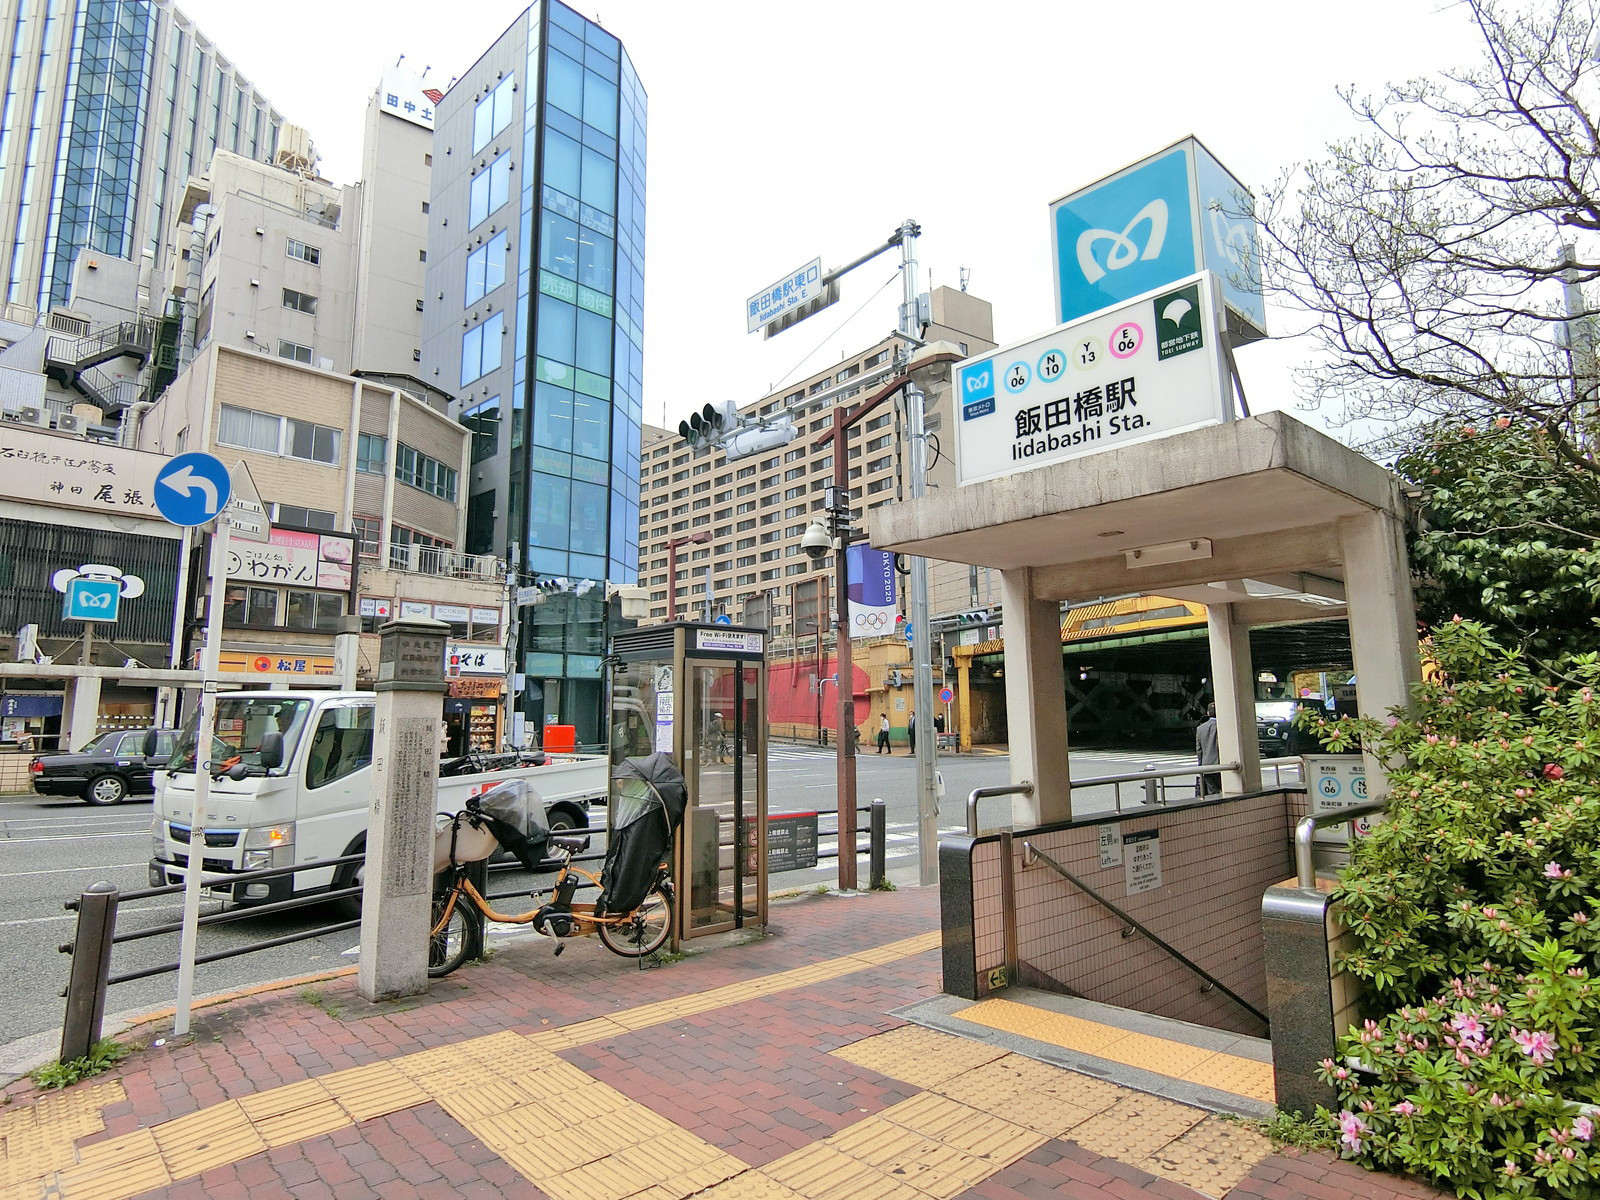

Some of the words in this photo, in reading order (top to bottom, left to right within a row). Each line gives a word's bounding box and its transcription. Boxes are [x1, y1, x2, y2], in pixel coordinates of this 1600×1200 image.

[749, 265, 818, 317] 飯田橋駅東口
[760, 301, 785, 322] Iidabashi
[1122, 329, 1128, 339] E
[1161, 331, 1199, 349] 都営地下鉄
[1083, 342, 1091, 352] Y
[1118, 338, 1135, 352] 06
[1162, 348, 1174, 356] TOEI
[1176, 340, 1199, 352] SUBWAY
[1047, 355, 1055, 365] N
[1081, 351, 1096, 364] 13
[1014, 366, 1020, 376] T
[1045, 364, 1059, 376] 10
[1011, 375, 1025, 387] 06
[968, 402, 990, 413] 東京メトロ
[1015, 376, 1138, 439] 飯田橋駅
[1012, 420, 1101, 460] Iidabashi
[1109, 414, 1151, 435] Sta.
[50, 481, 83, 494] 神田
[94, 484, 155, 508] 尾張
[247, 559, 313, 582] わがん
[883, 552, 891, 577] OKYO
[884, 579, 892, 602] 2020
[277, 659, 306, 672] 松屋
[461, 652, 488, 667] そば
[173, 810, 237, 822] FSO
[1102, 856, 1112, 866] Left
